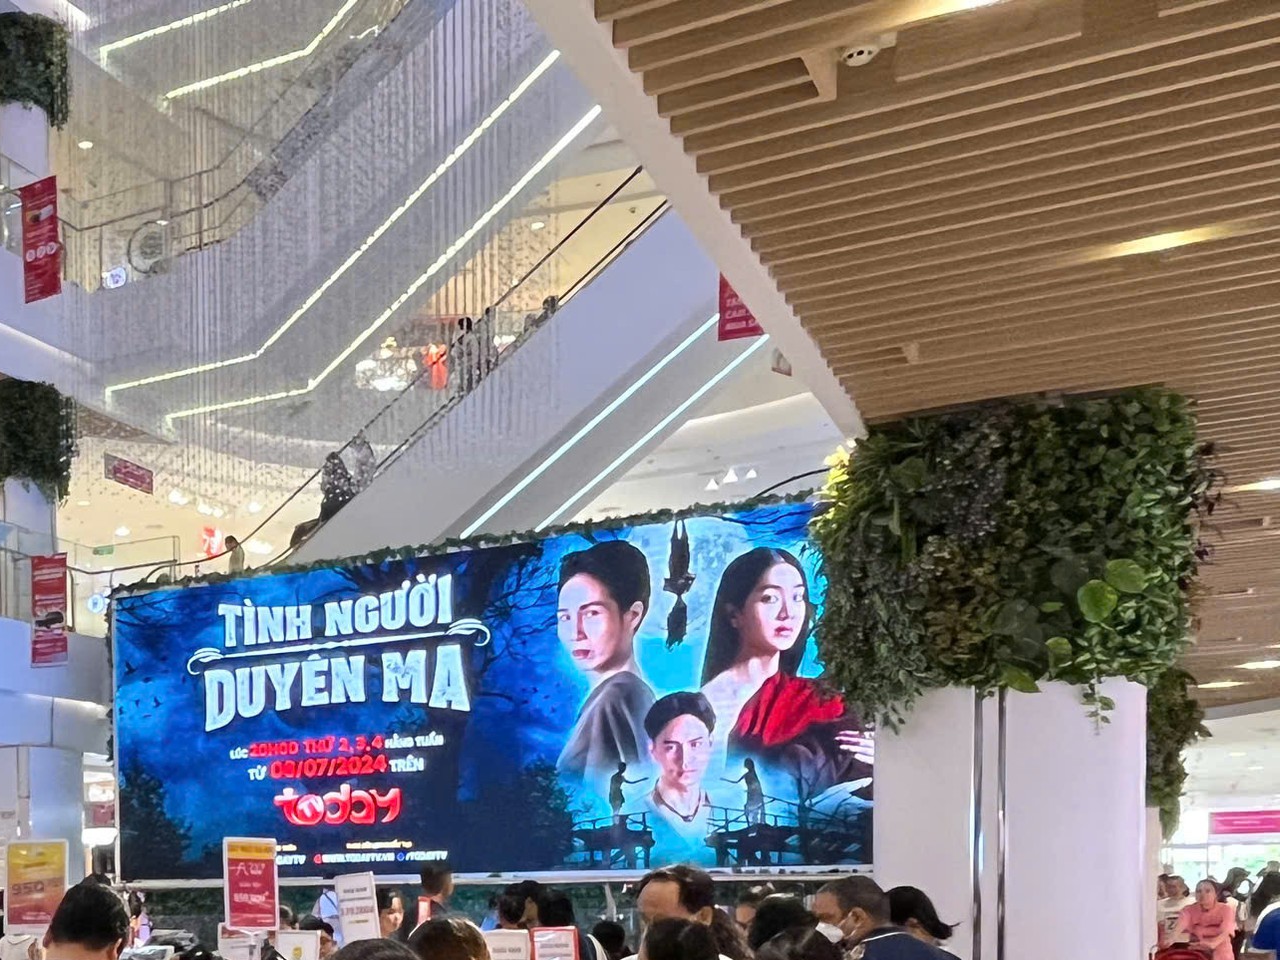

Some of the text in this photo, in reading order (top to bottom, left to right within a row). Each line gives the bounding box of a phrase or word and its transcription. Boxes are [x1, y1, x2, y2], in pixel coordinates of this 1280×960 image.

[218, 573, 452, 648] TÌNH NGƯỜI
[204, 644, 471, 732] DUYÊN MA
[389, 754, 425, 773] TRÊN
